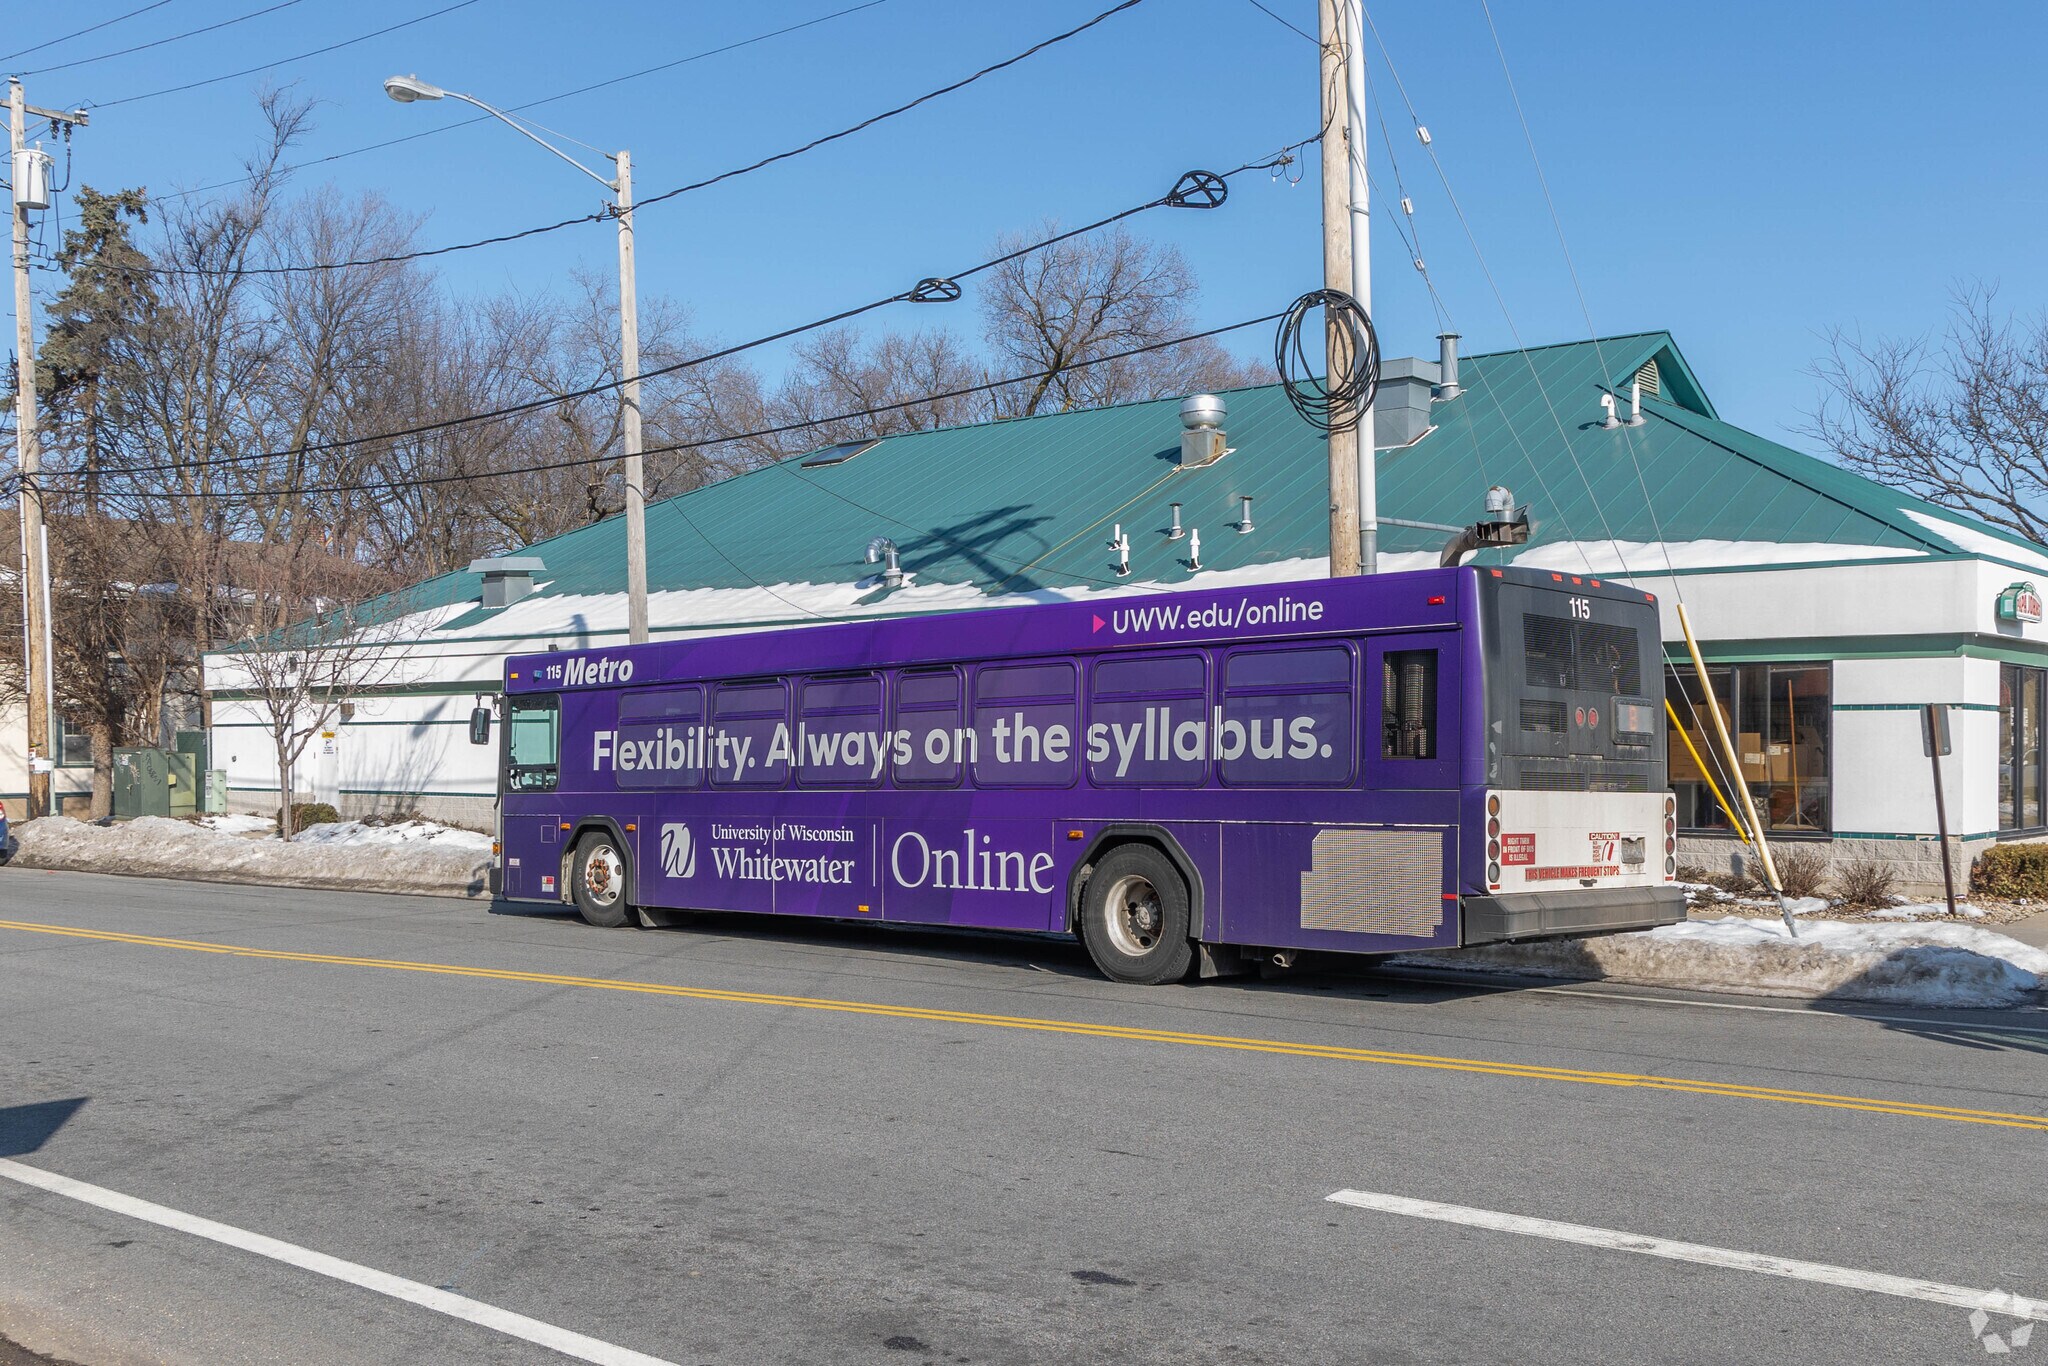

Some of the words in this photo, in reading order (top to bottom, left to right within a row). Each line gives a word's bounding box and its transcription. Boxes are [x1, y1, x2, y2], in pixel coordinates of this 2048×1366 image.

[1113, 597, 1324, 634] UWW.edu/online
[1569, 597, 1590, 620] 115
[546, 665, 562, 680] 115
[563, 657, 634, 686] Metro
[593, 726, 756, 782] Flexibility.
[764, 721, 913, 780] Always
[924, 727, 978, 765] on
[992, 712, 1071, 764] the
[1087, 705, 1333, 777] syllabus.
[711, 823, 772, 846] University
[774, 823, 787, 842] of
[788, 824, 855, 843] Wisconsin
[1508, 845, 1520, 853] FRONT
[1514, 853, 1528, 861] ILLEGAL
[711, 846, 856, 885] Whitewater
[891, 828, 1055, 894] Online
[1525, 868, 1538, 880] THIS
[1539, 867, 1559, 879] VEHICLE
[1560, 867, 1578, 878] MAKES
[1579, 866, 1602, 877] FREQUENT
[1603, 865, 1620, 876] STOPS
